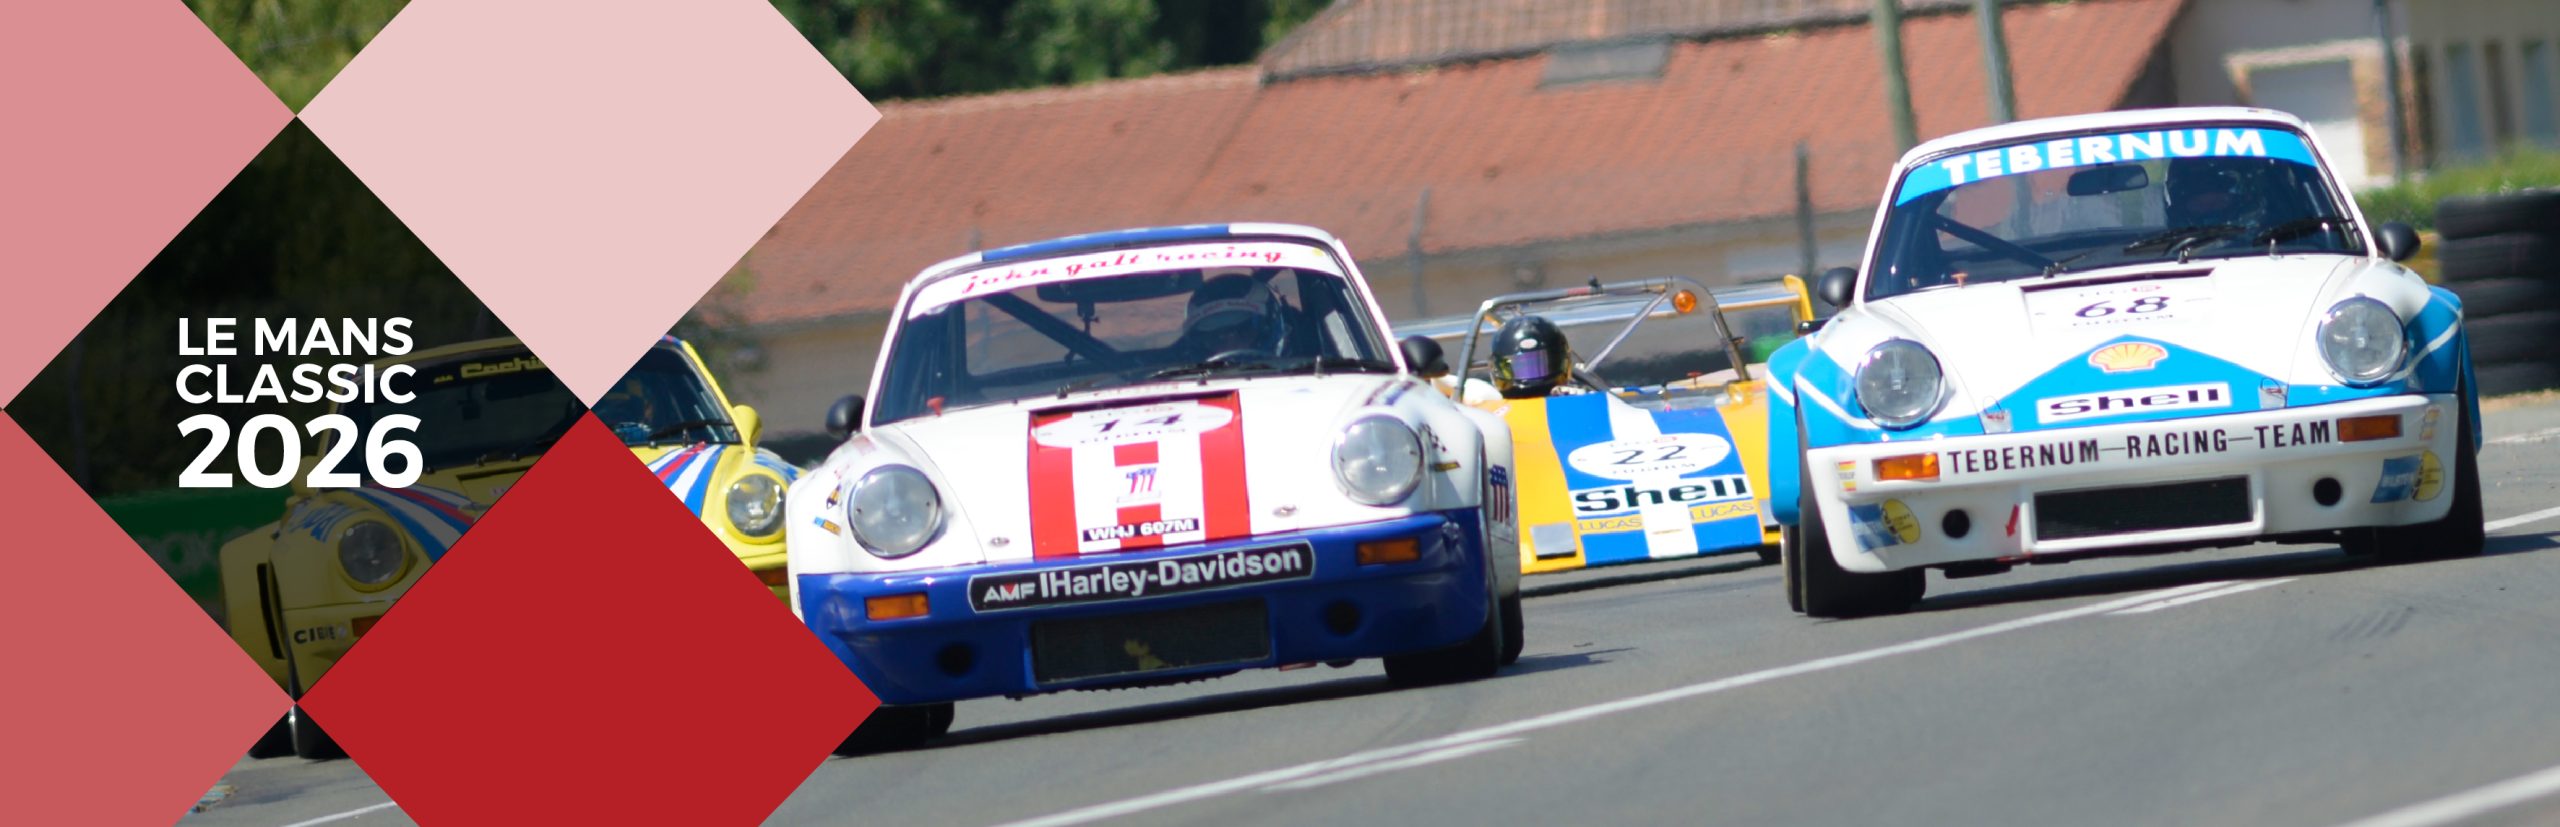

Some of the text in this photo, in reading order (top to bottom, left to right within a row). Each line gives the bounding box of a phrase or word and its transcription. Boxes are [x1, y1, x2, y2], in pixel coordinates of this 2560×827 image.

[1942, 128, 2266, 185] TEBERNUM
[1155, 246, 1282, 264] racing
[2074, 295, 2171, 318] 68
[2050, 388, 2220, 416] Shell
[1092, 411, 1184, 434] 14
[1610, 445, 1688, 466] 22
[1575, 477, 1748, 512] Shell
[1578, 515, 1642, 531] LUCAS
[1691, 502, 1755, 521] LUCAS
[1088, 518, 1195, 541] WHJ 607M
[984, 581, 1036, 602] AMF
